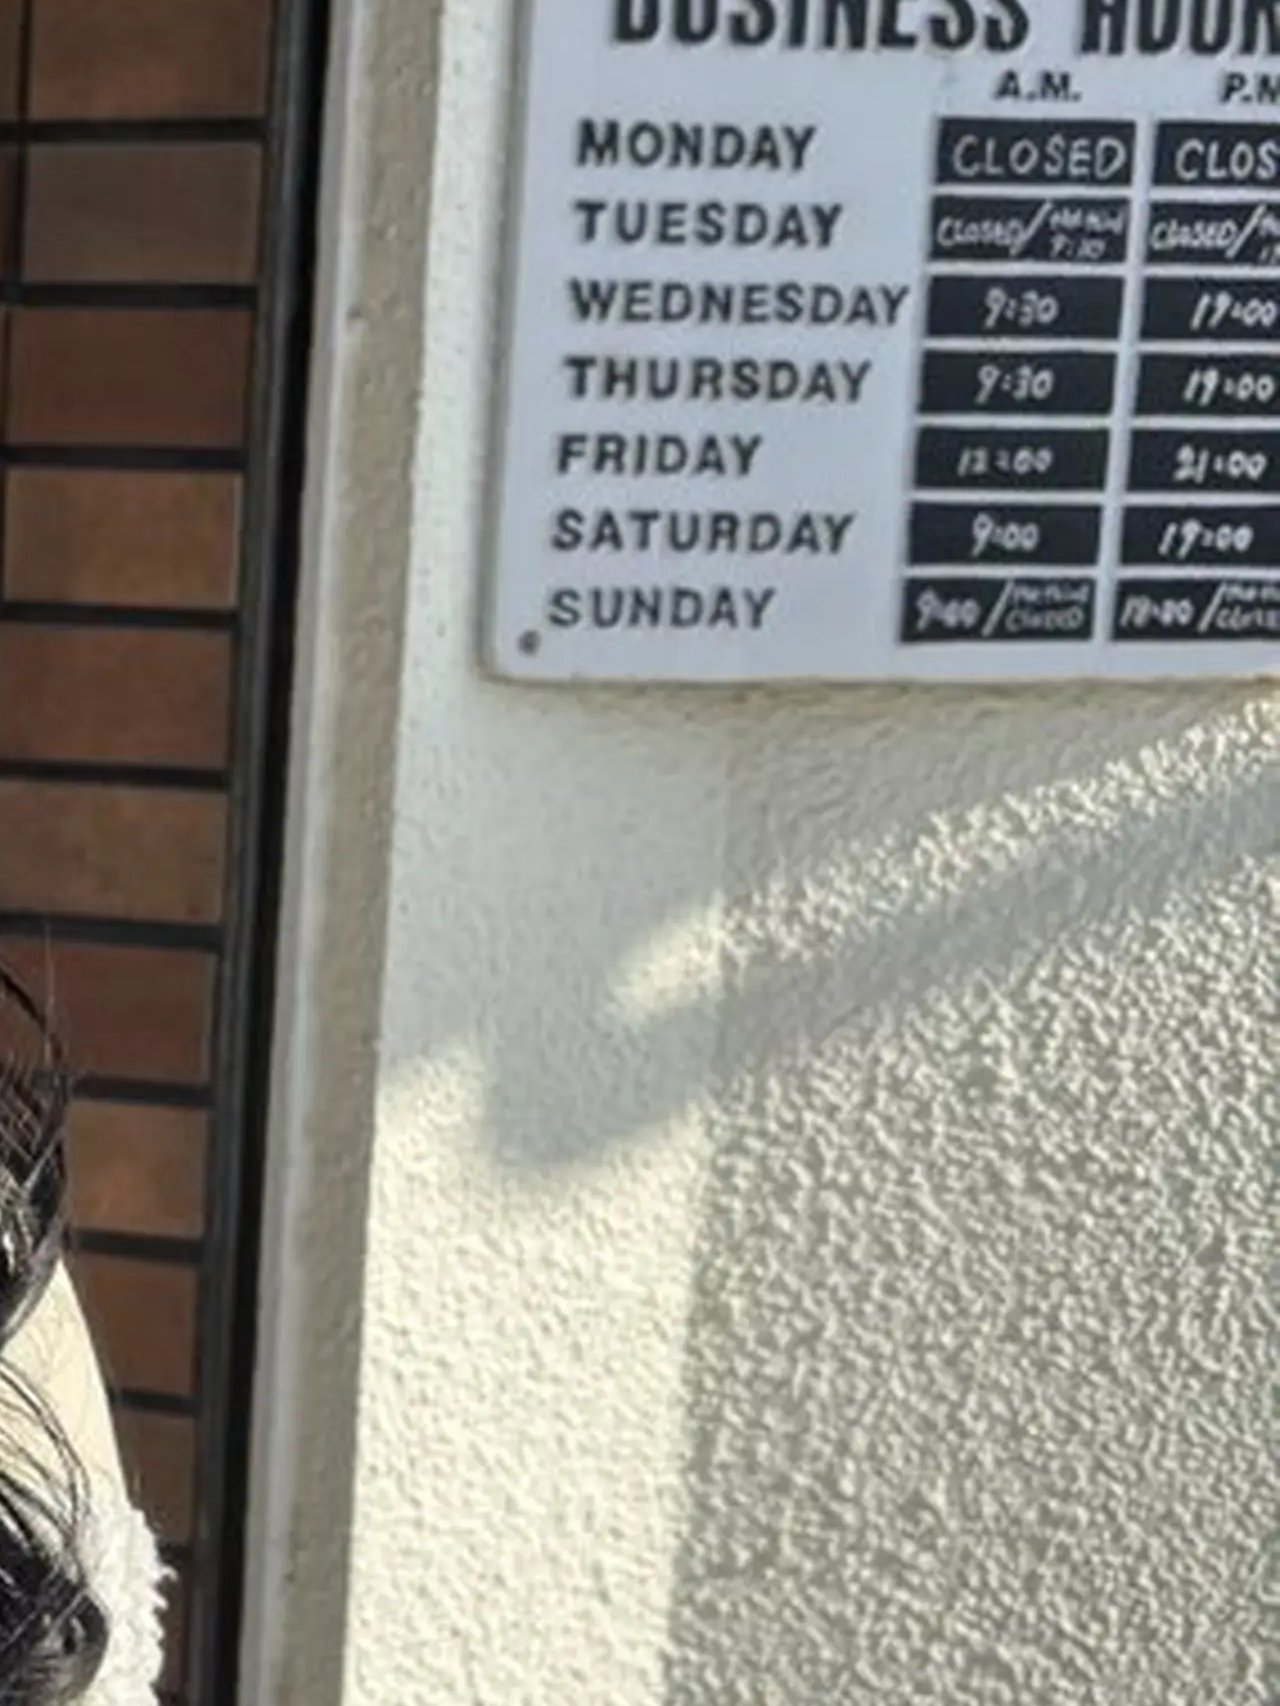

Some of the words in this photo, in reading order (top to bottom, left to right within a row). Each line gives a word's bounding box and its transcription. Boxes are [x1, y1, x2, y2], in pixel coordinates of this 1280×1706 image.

[995, 70, 1081, 102] A.M.
[576, 118, 815, 170] MONDAY
[952, 134, 1127, 179] CLOSED
[573, 199, 841, 247] TUESDAY
[568, 277, 910, 325] WEDNESDAY
[984, 287, 1059, 329] 9:30
[1190, 291, 1277, 329] 19:00
[564, 356, 871, 403] THURSDAY
[975, 364, 1054, 405] 9:30
[1183, 368, 1275, 406] 19:00
[556, 434, 762, 476] FRIDAY
[1173, 445, 1267, 482] 21:00
[552, 509, 855, 555] SATURDAY
[972, 513, 1039, 557] 9:00
[1158, 519, 1253, 559] 19:00
[548, 587, 777, 629] SUNDAY
